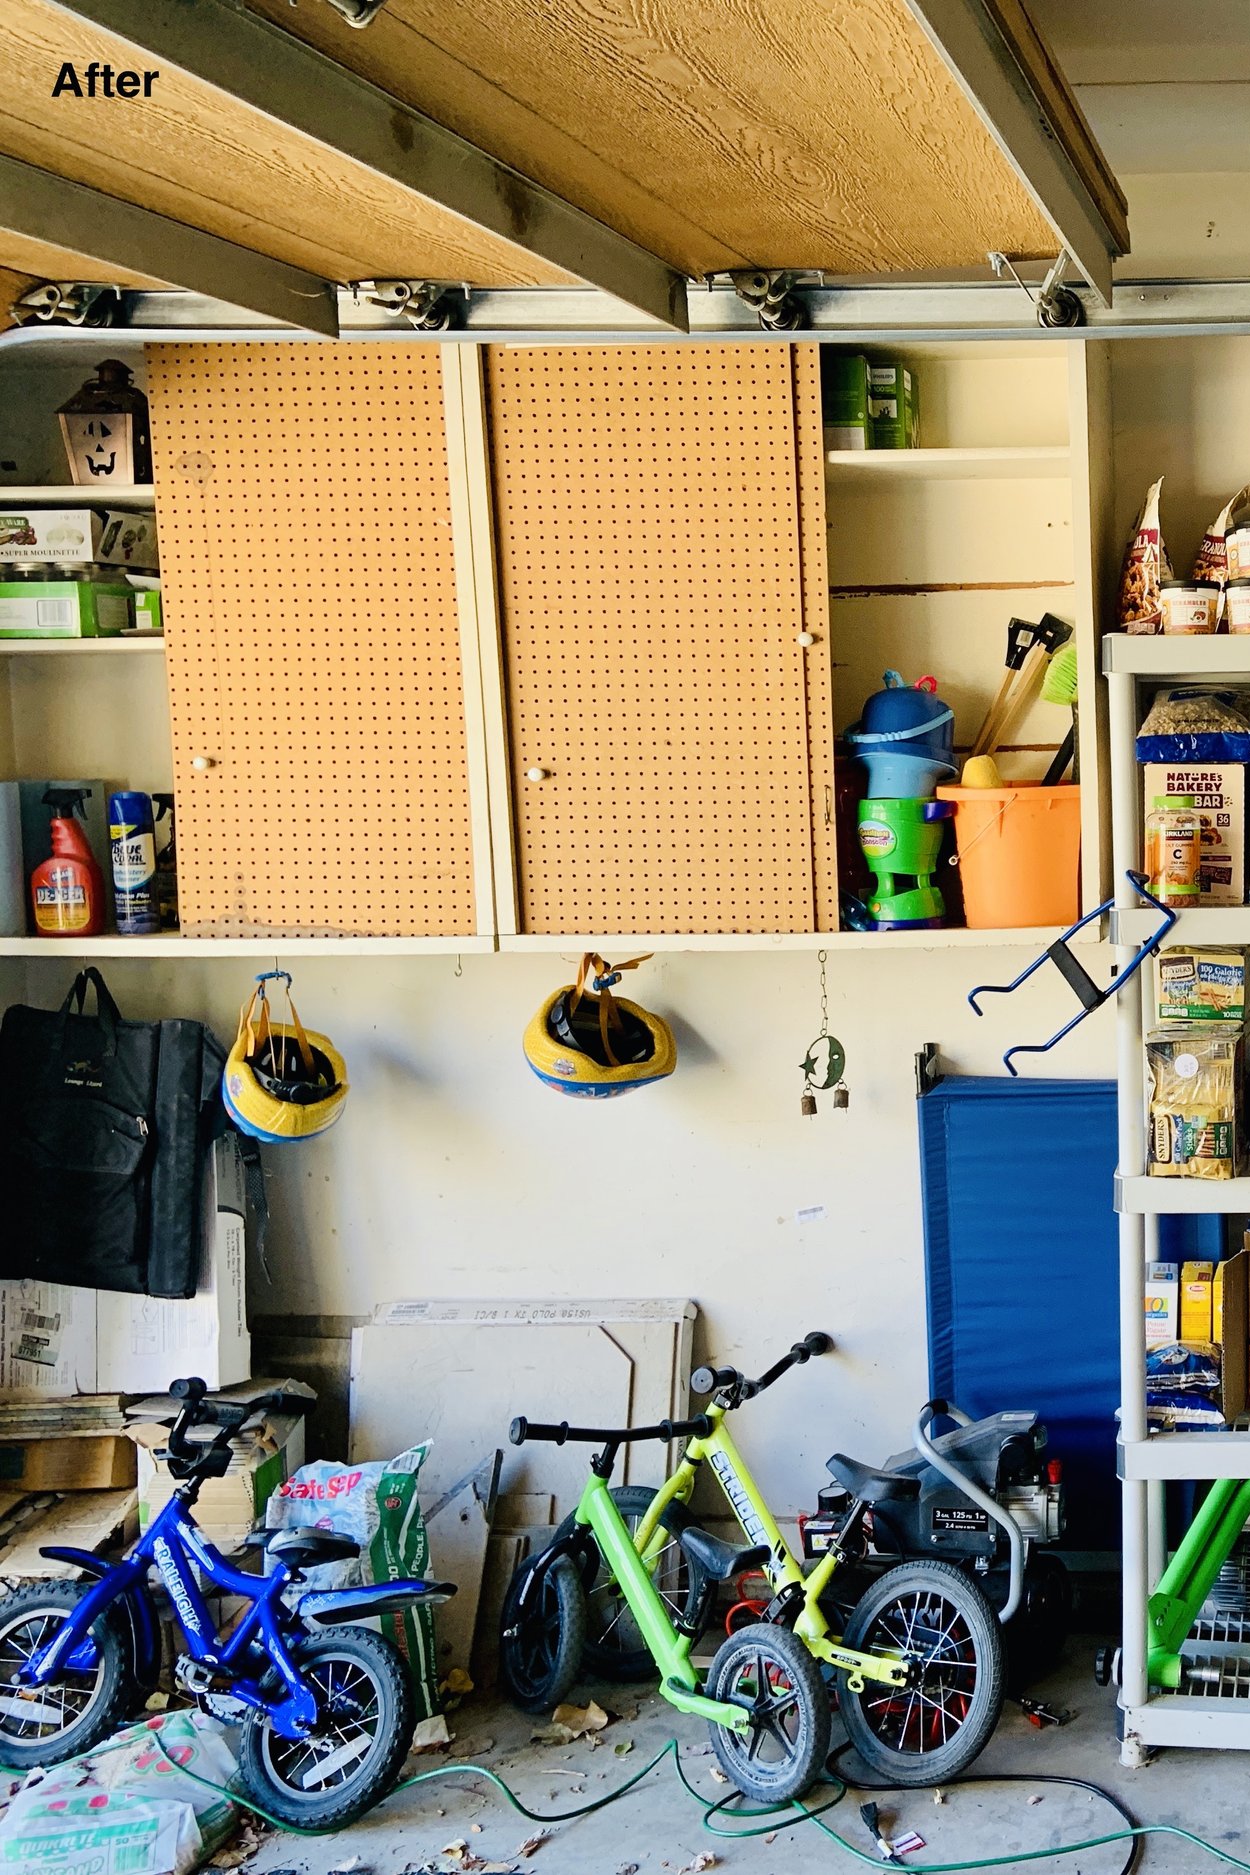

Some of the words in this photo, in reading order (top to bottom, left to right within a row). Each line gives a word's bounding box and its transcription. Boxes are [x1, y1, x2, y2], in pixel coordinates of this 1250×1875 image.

[1167, 782, 1222, 792] BAKERY
[1195, 796, 1221, 807] BAR
[1218, 815, 1229, 824] 36
[1173, 849, 1182, 859] C
[1215, 966, 1242, 976] Calorie
[532, 1310, 555, 1319] POLO
[711, 1451, 771, 1546] STRIDER
[410, 1532, 424, 1572] PEOPLE,
[158, 1547, 200, 1627] RALEIGH
